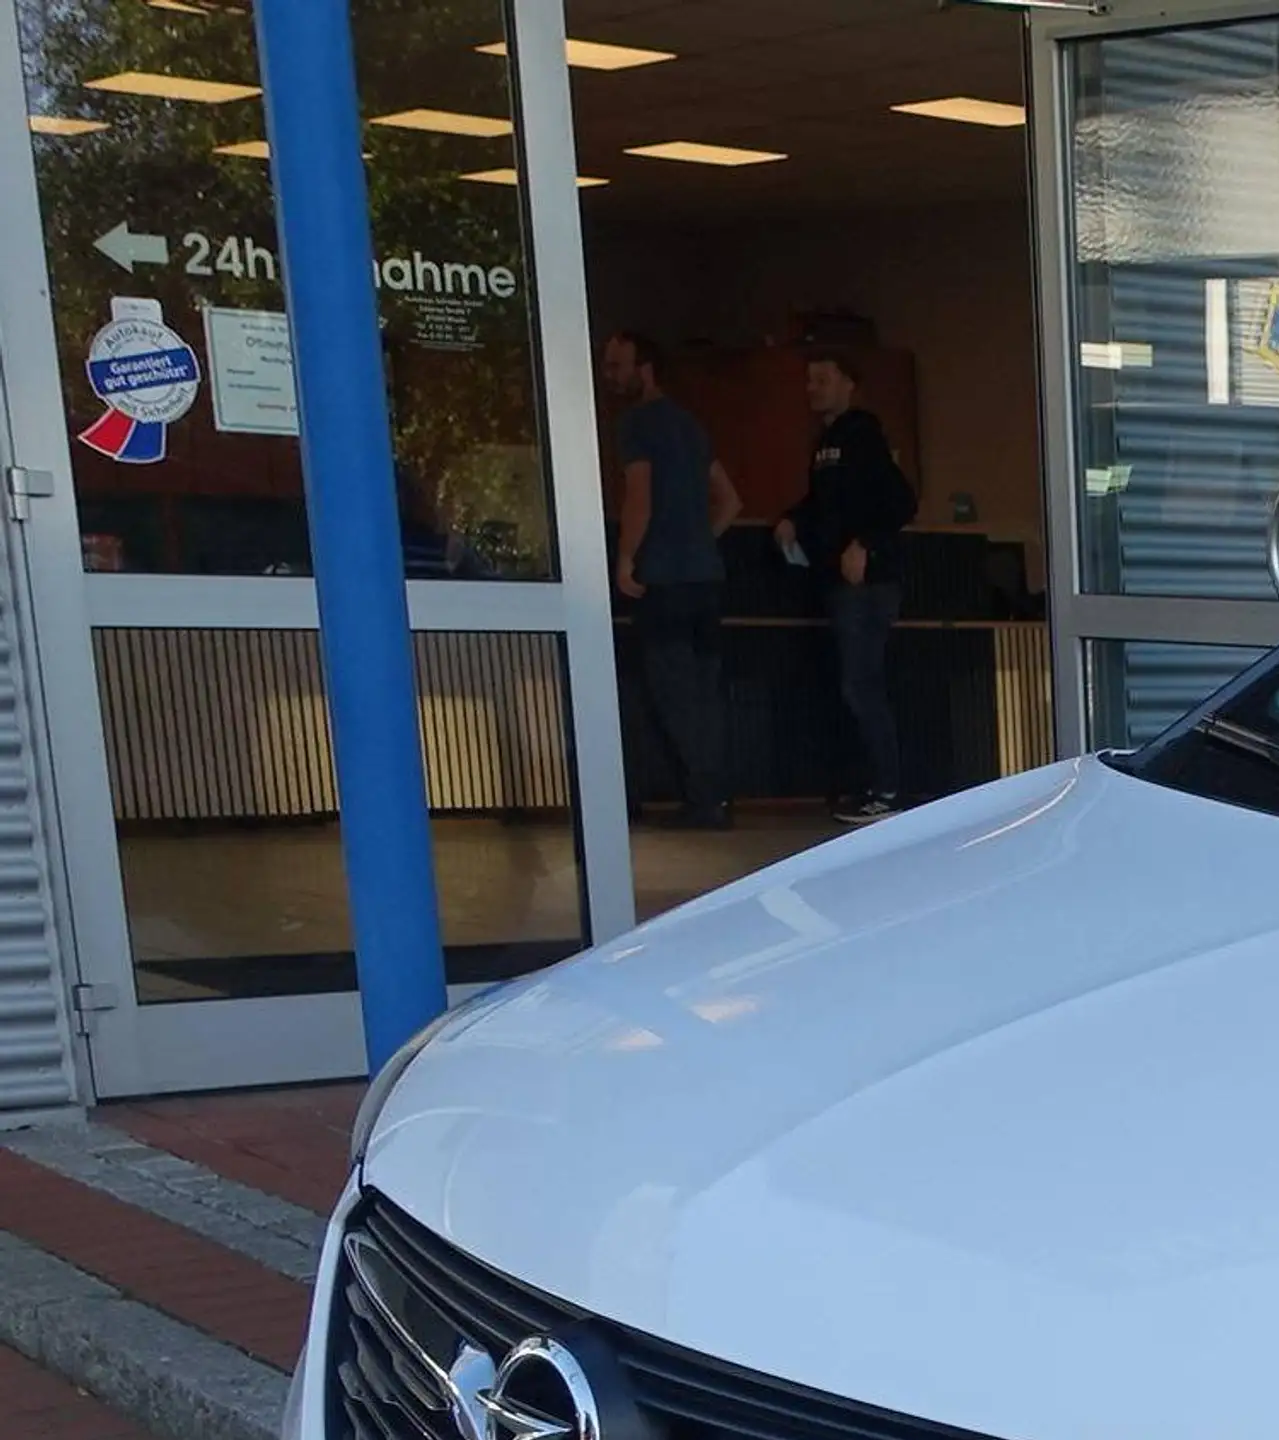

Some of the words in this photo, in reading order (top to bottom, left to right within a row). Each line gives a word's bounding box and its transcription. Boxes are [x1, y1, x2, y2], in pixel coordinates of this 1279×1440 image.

[372, 251, 516, 298] ahme
[109, 356, 173, 376] Garantiert
[104, 374, 128, 392] gut
